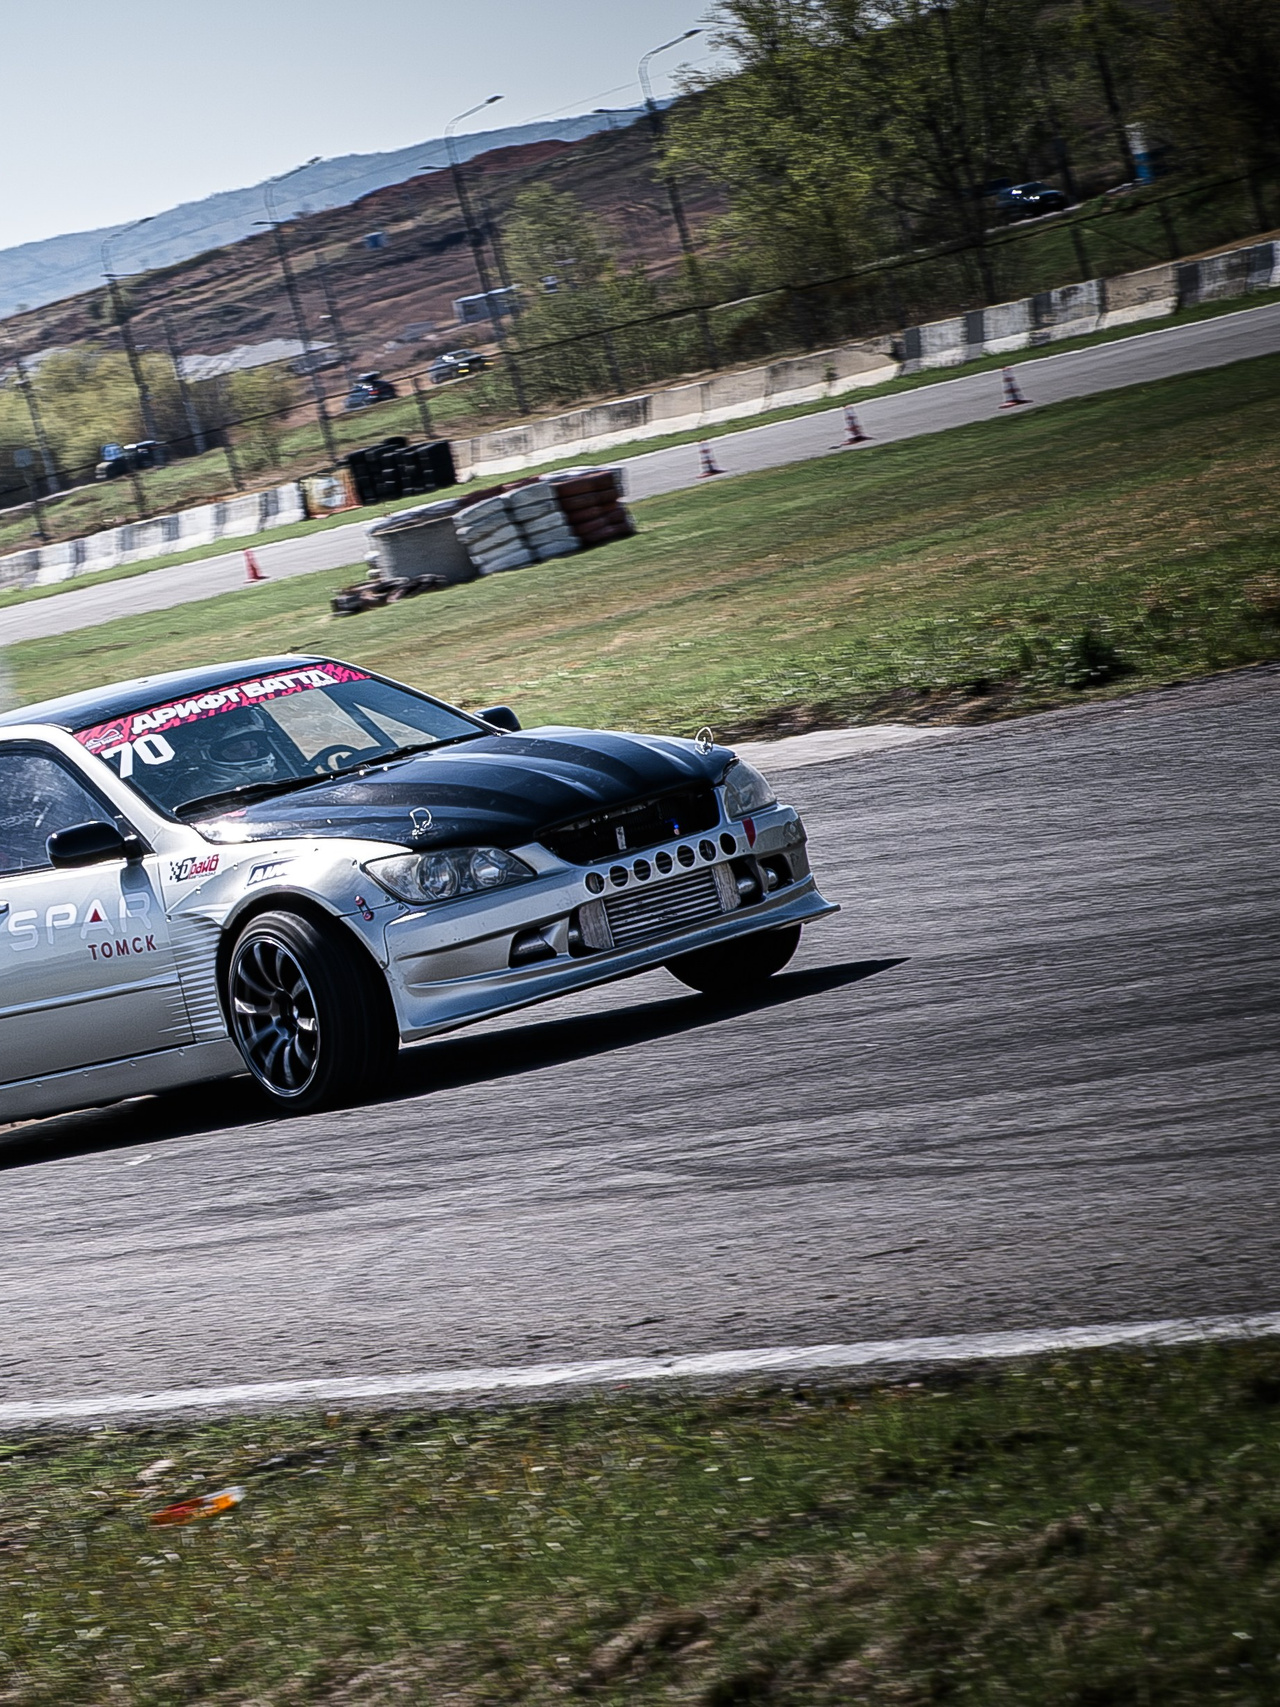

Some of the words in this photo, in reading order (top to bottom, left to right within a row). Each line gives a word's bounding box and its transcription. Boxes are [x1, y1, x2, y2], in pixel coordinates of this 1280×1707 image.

[131, 687, 241, 734] ДРИФТ
[101, 733, 176, 779] 70
[8, 892, 152, 951] SPAR
[88, 934, 157, 961] ТОМСК
